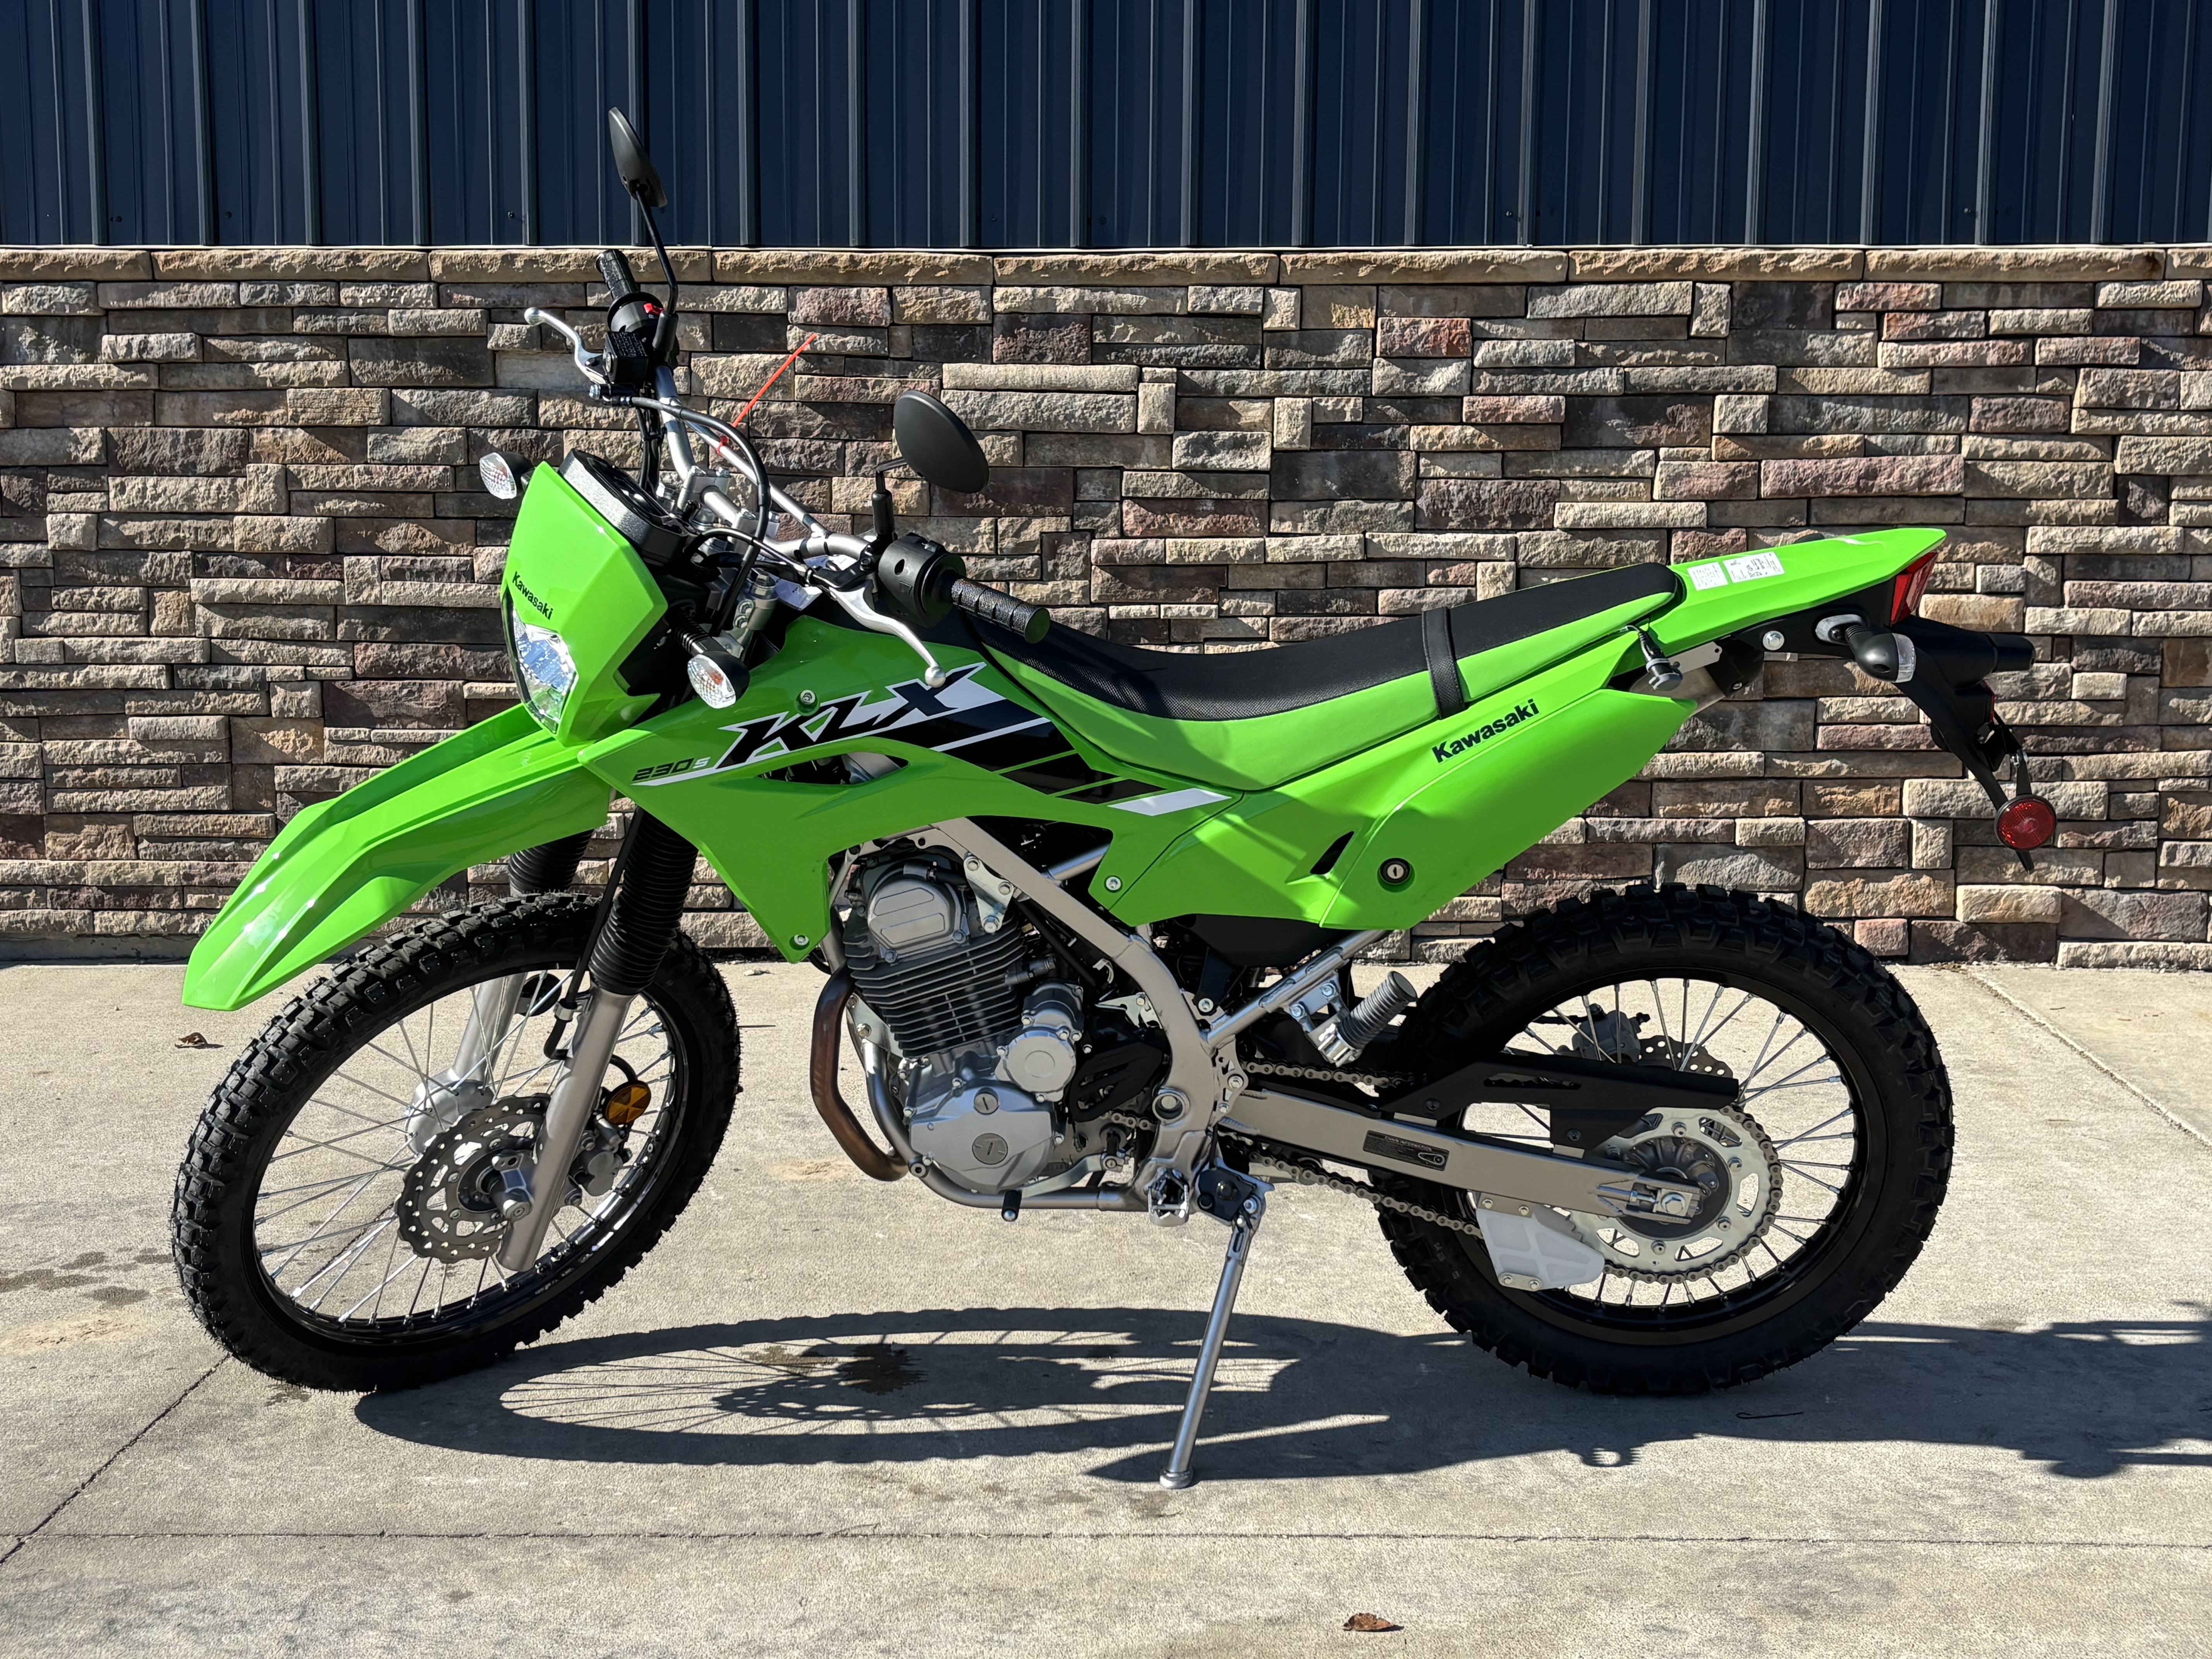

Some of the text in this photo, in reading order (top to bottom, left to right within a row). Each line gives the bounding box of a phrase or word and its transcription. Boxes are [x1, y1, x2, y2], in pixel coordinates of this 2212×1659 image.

[512, 571, 554, 620] Kawasaki
[718, 661, 987, 769] KLX
[1432, 698, 1540, 764] Kawasaki
